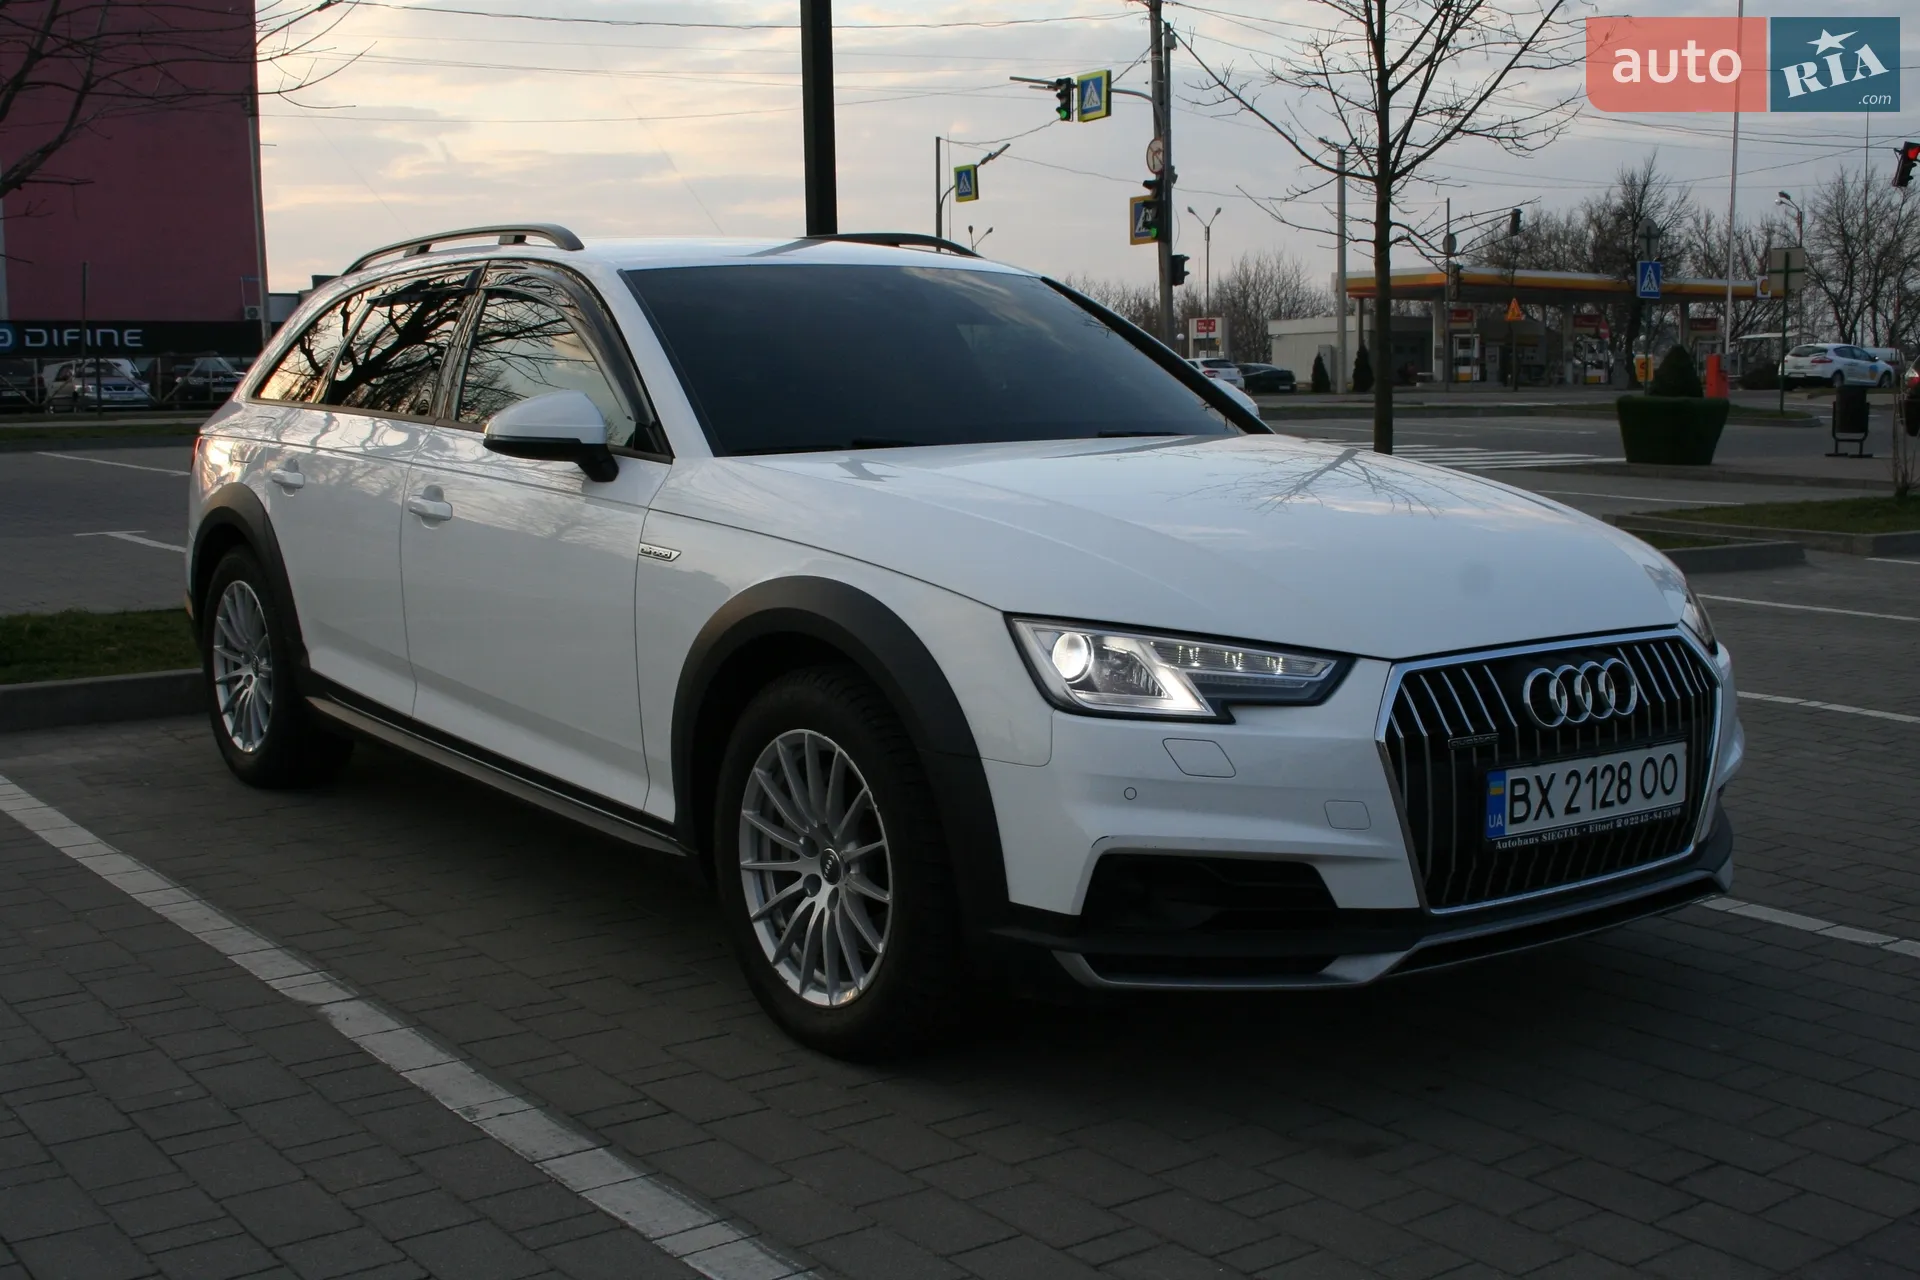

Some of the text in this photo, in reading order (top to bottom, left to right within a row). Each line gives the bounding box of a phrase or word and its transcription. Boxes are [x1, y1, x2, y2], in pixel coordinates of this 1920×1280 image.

[24, 328, 144, 347] DIFINE
[1509, 772, 1556, 825] BX
[1564, 761, 1632, 815] 2128
[1488, 813, 1504, 829] UA
[1495, 835, 1540, 850] Autohaus
[1541, 827, 1580, 843] SIEGTAL
